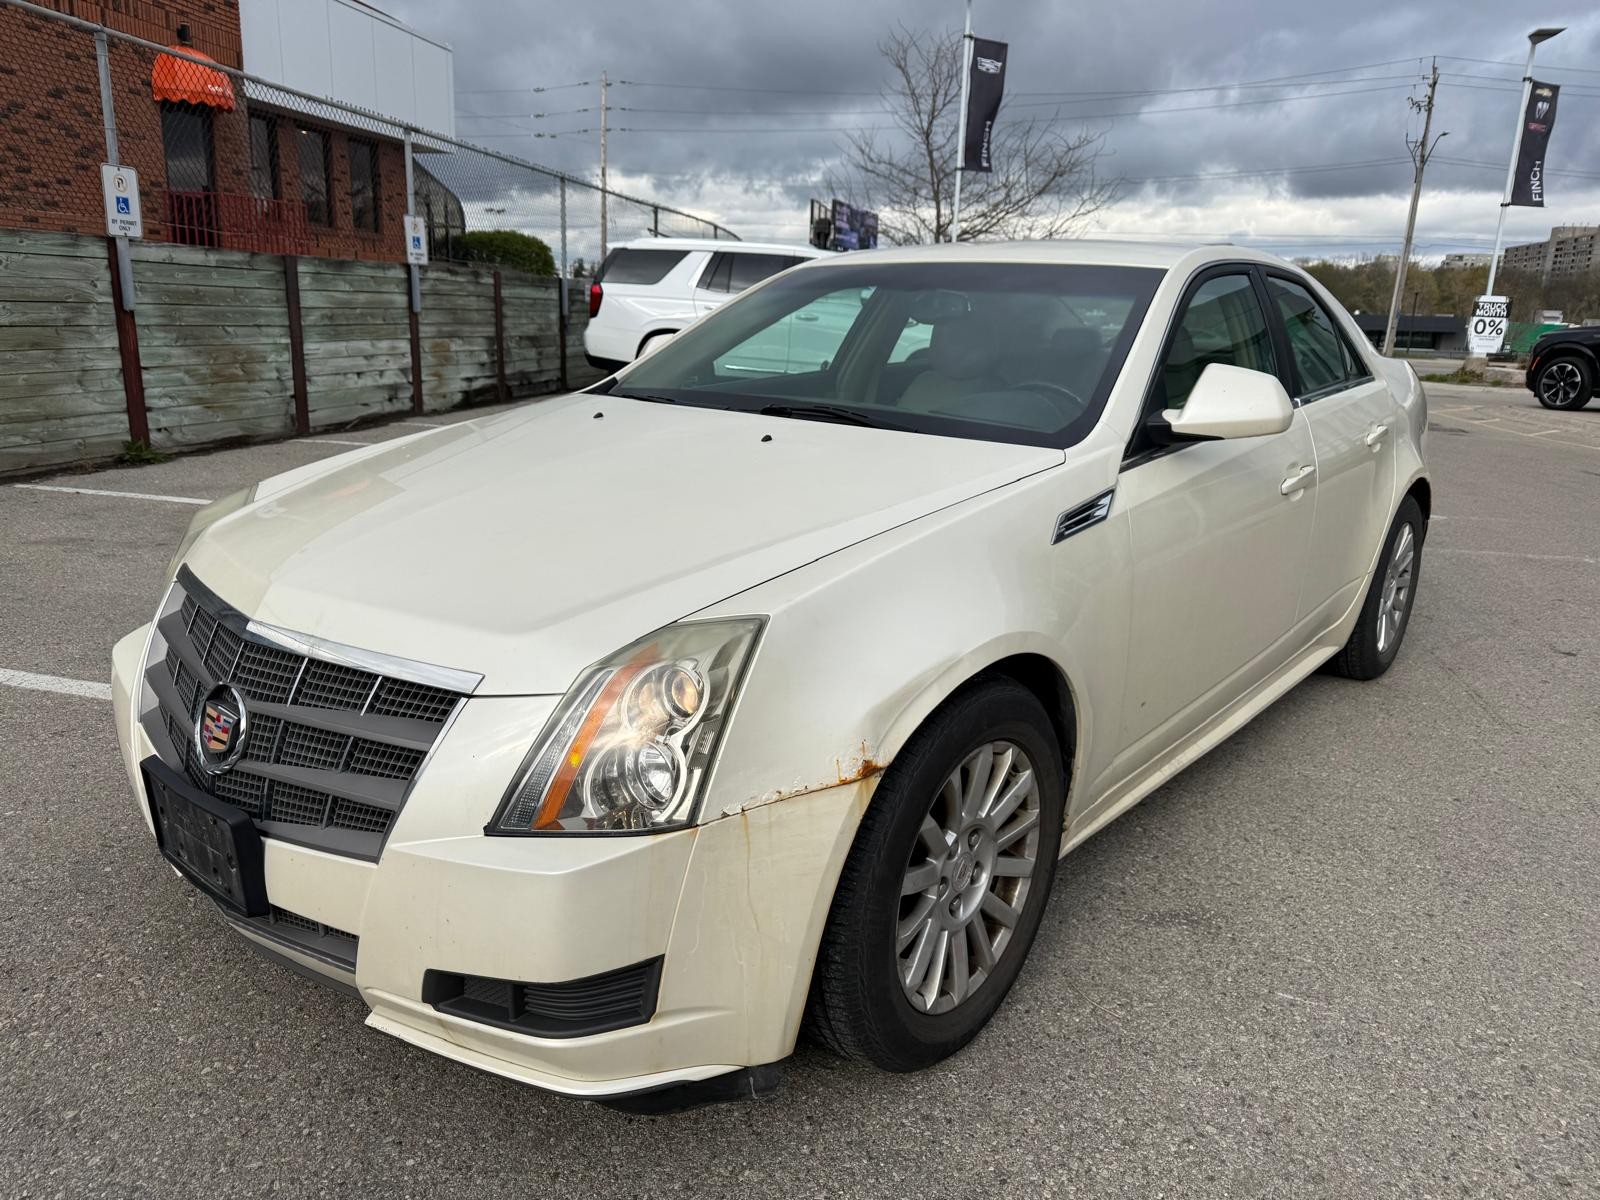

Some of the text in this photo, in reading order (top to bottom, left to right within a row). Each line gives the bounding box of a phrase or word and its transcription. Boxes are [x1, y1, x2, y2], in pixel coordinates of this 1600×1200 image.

[1530, 160, 1542, 202] FINCH
[1479, 302, 1507, 310] TRUCK
[1476, 309, 1507, 317] MONTH
[1474, 319, 1503, 335] 0%
